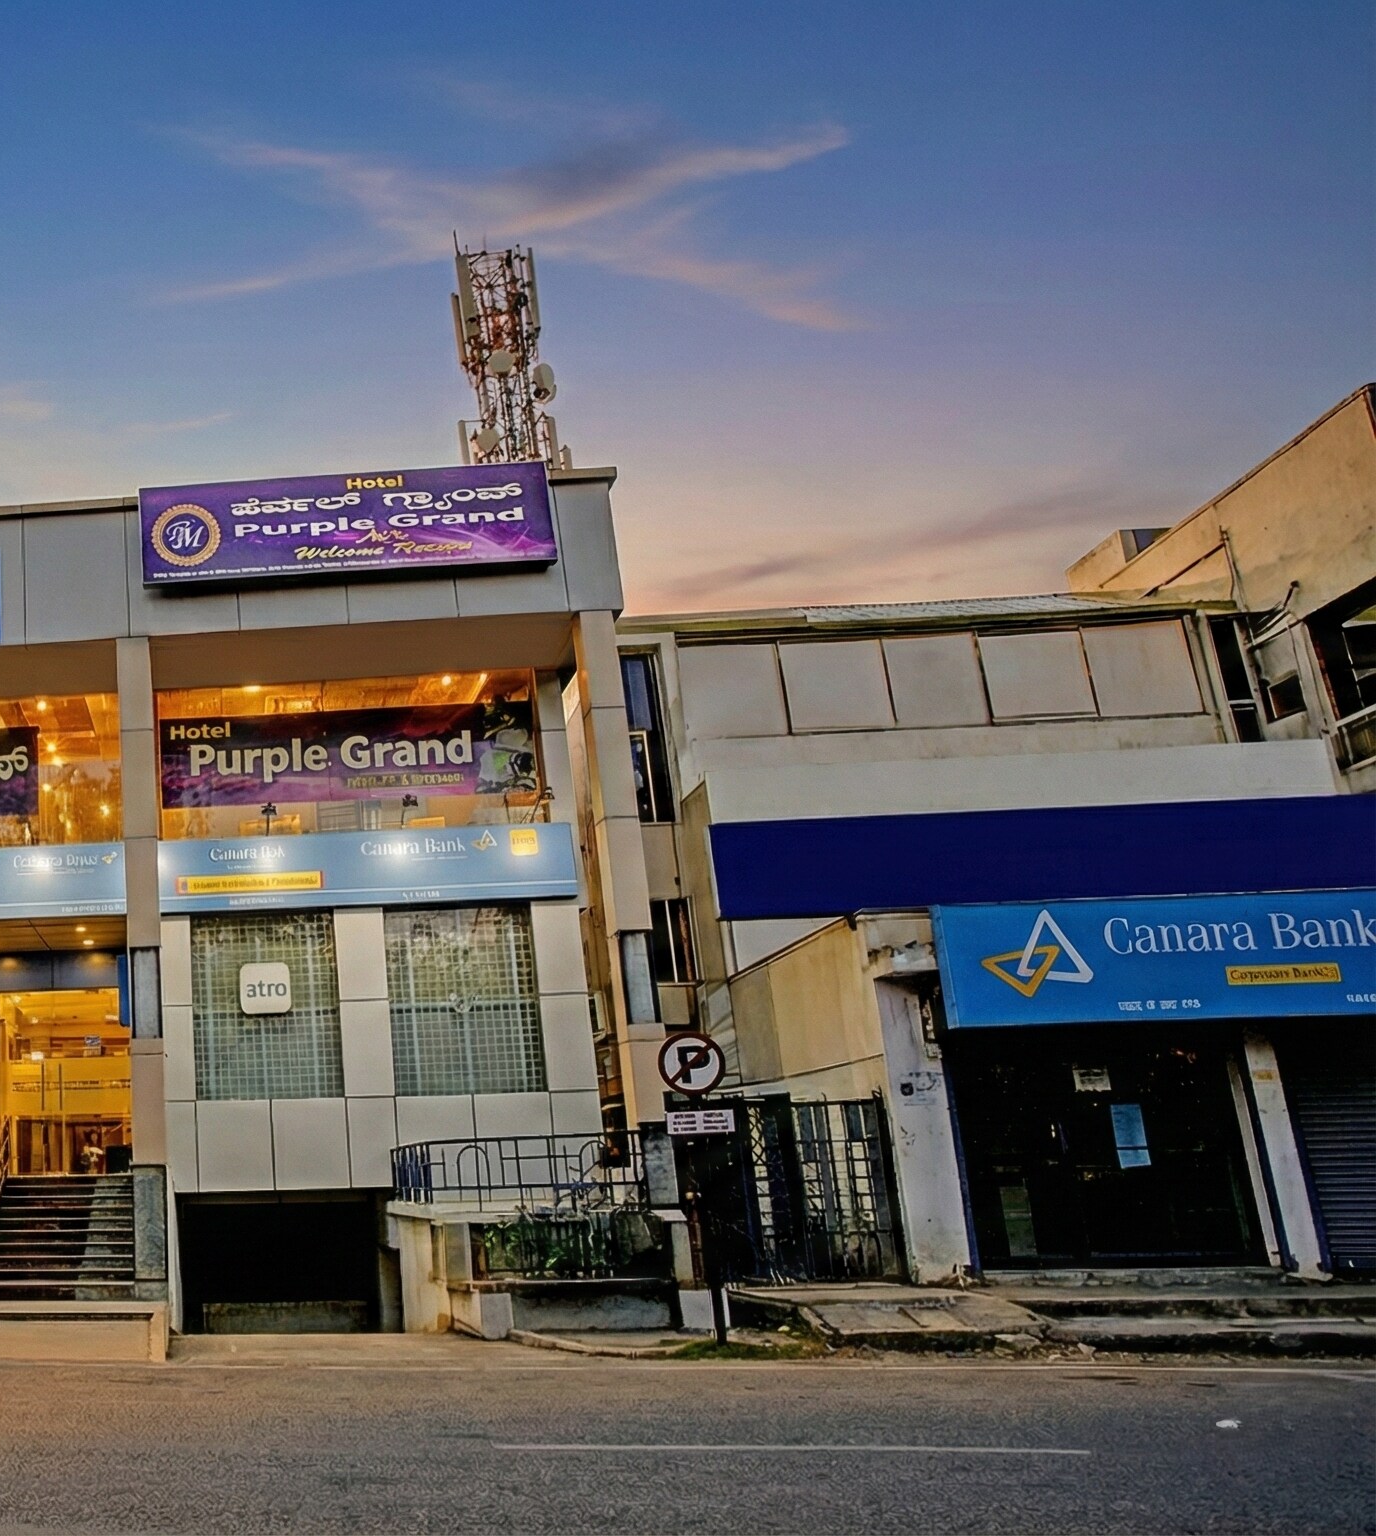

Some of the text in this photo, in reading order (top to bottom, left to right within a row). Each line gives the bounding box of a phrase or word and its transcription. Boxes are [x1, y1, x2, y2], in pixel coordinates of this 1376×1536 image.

[346, 475, 404, 490] Hotel
[234, 516, 375, 537] Purple
[388, 507, 524, 528] Grand
[169, 722, 231, 740] Hotel
[189, 730, 473, 783] Purple Grand
[1103, 909, 1376, 955] Canara Bank
[246, 980, 287, 998] atro
[677, 1045, 711, 1084] P
